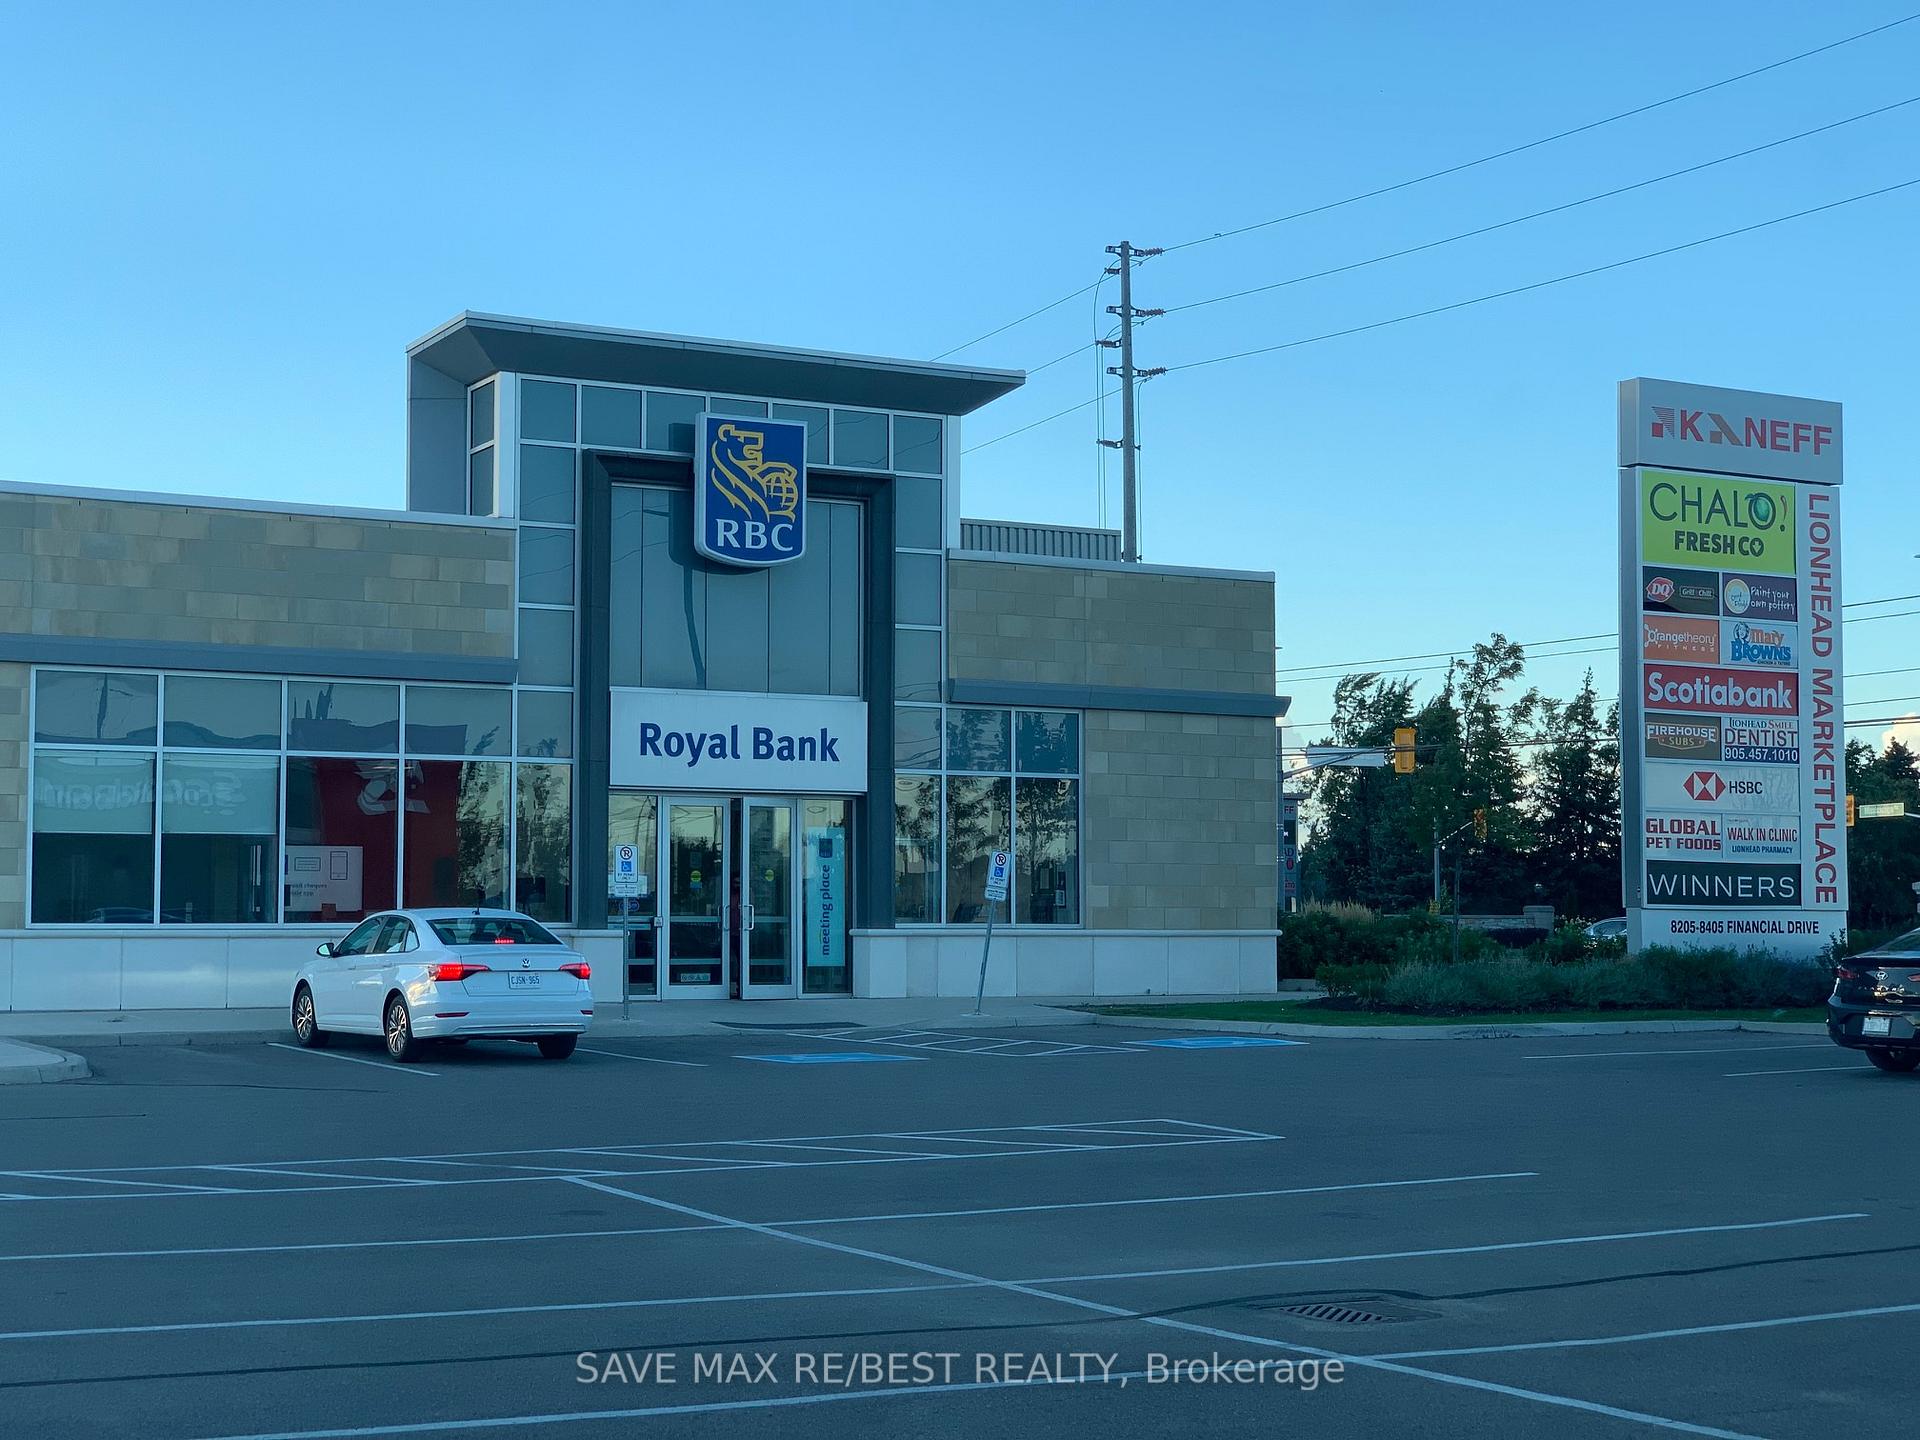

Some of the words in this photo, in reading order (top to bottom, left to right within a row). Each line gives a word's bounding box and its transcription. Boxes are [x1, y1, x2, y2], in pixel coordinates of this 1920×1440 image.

[716, 518, 793, 551] RBC
[1808, 493, 1832, 657] LIONHEAD
[1651, 583, 1670, 597] DQ
[1750, 586, 1770, 598] Paint
[1772, 590, 1790, 602] your
[1750, 600, 1766, 608] own
[1768, 601, 1796, 615] pottery
[1657, 644, 1715, 652] FITNESS
[1648, 672, 1792, 709] Scotiabank
[1647, 724, 1716, 743] FIREHOUSE
[1668, 736, 1695, 746] SUBS
[1725, 729, 1798, 747] DENTIST
[639, 722, 740, 767] Royal
[752, 726, 840, 762] Bank
[1725, 747, 1798, 761] 905.457.1010
[1729, 780, 1763, 795] HSBC
[1812, 668, 1837, 904] MARKETPLACE
[1646, 818, 1721, 836] GLOBAL
[1727, 827, 1754, 841] WALK
[1756, 828, 1766, 841] IN
[1768, 828, 1798, 842] CLINIC
[1646, 837, 1673, 849] PET
[1676, 838, 1721, 850] FOODS
[821, 864, 834, 900] place
[1649, 873, 1795, 898] WINNERS
[821, 904, 834, 956] meeting
[1670, 920, 1724, 934] 8205-8405
[1727, 920, 1785, 934] FINANCIAL
[1787, 921, 1820, 934] DRIVE
